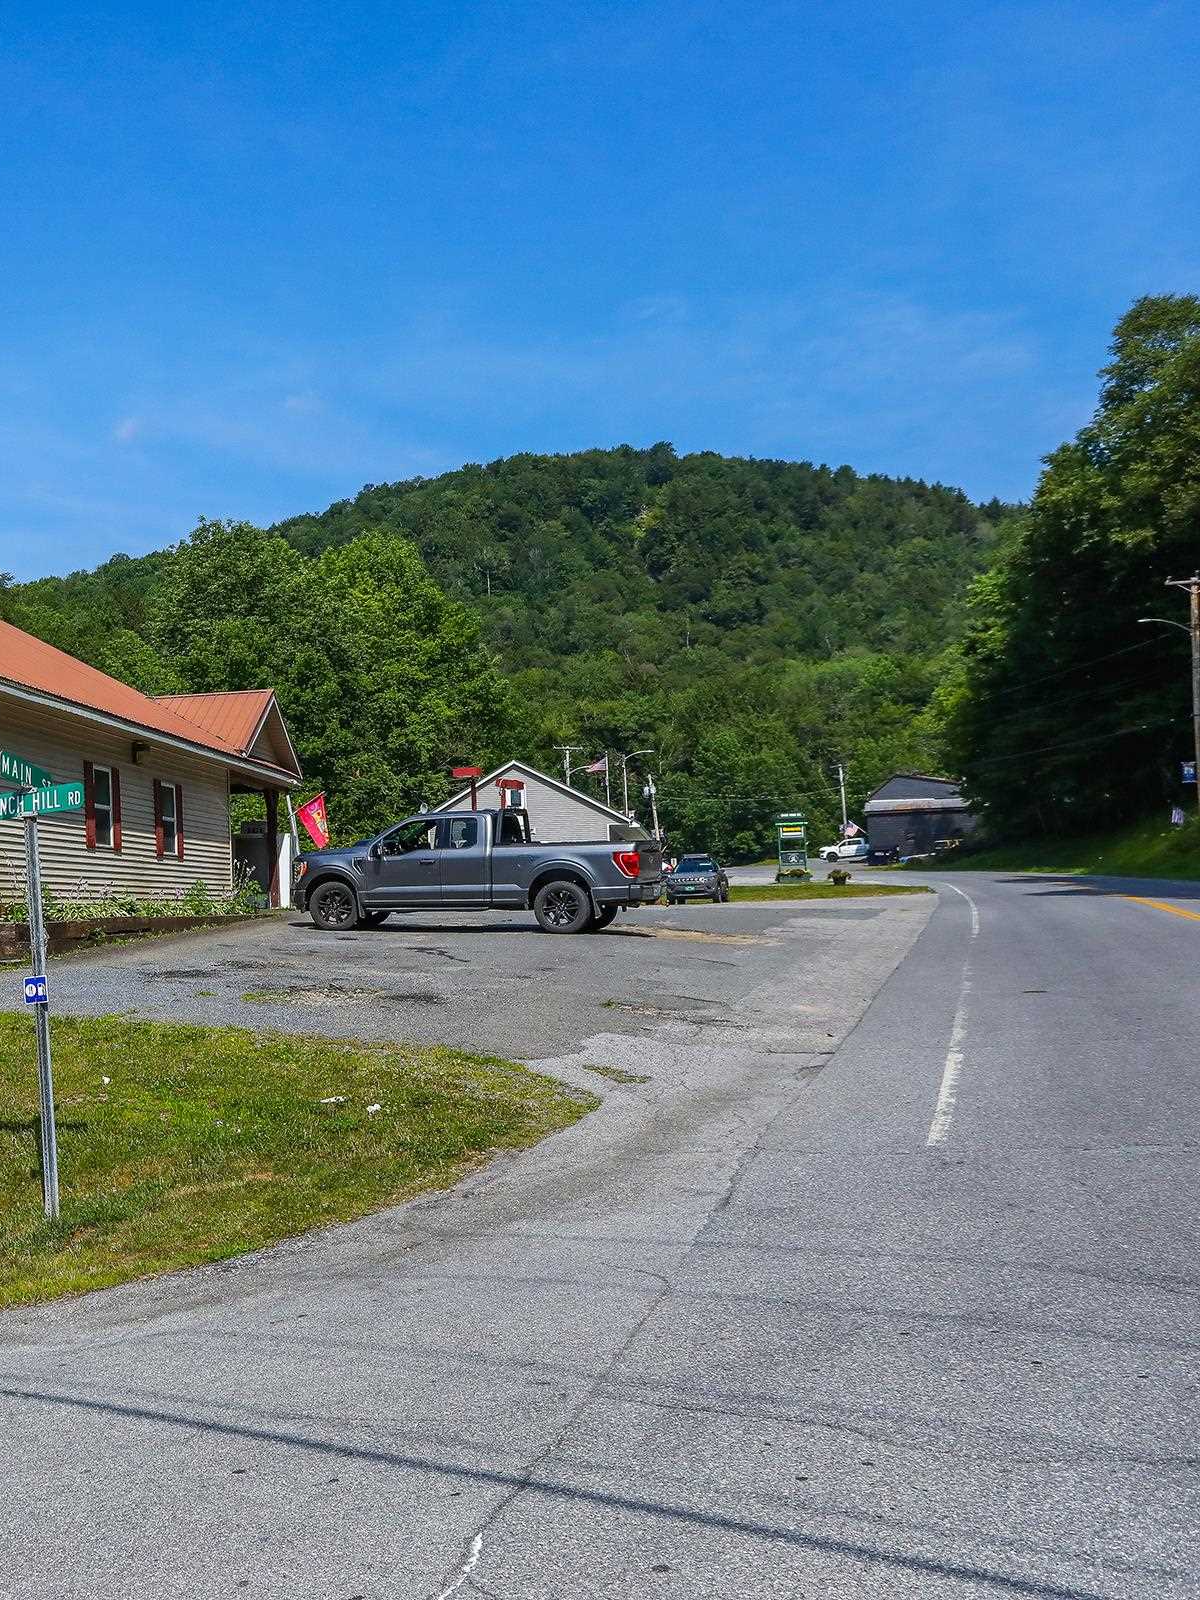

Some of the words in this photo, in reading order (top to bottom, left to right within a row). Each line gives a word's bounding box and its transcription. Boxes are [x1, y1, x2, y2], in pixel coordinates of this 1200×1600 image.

[2, 754, 32, 786] MAIN
[32, 789, 61, 811] HILL
[68, 790, 81, 806] RD
